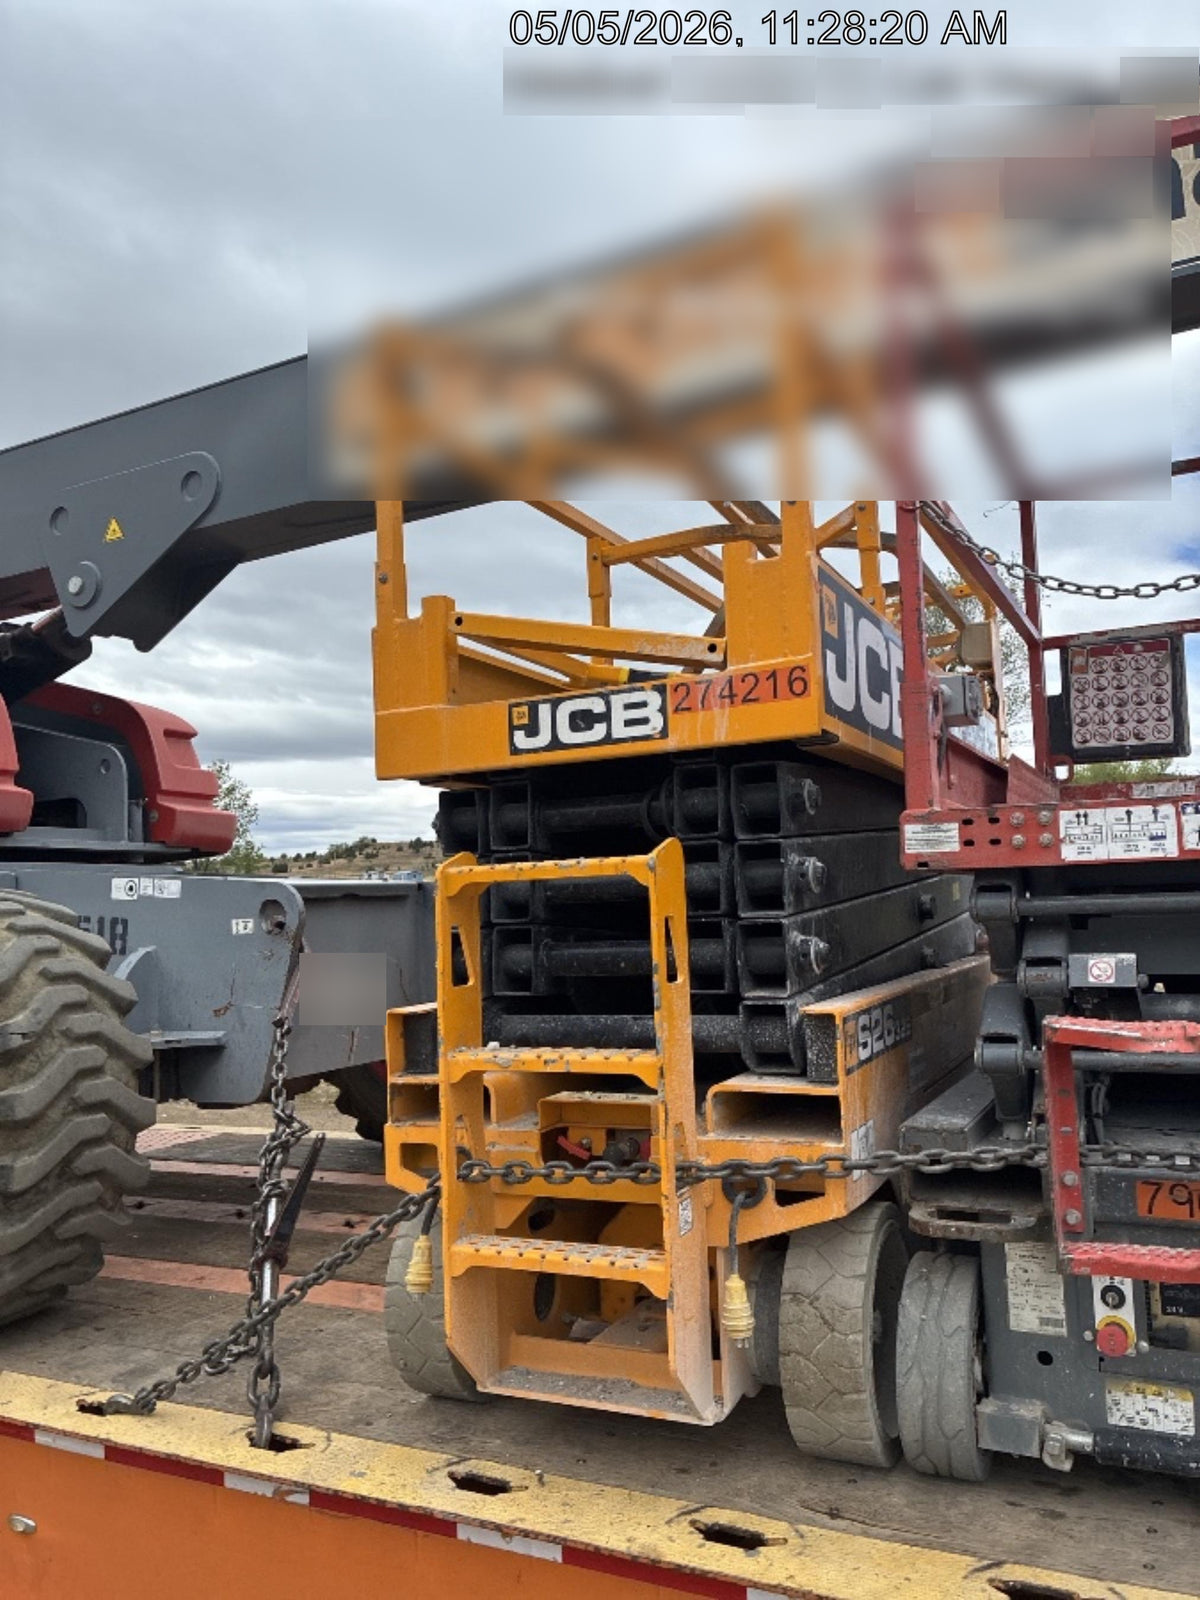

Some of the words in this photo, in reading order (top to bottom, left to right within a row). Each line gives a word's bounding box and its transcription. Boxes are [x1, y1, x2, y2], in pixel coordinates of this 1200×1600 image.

[673, 666, 808, 713] 274216
[513, 690, 664, 750] JCB
[1141, 1180, 1200, 1219] 79
